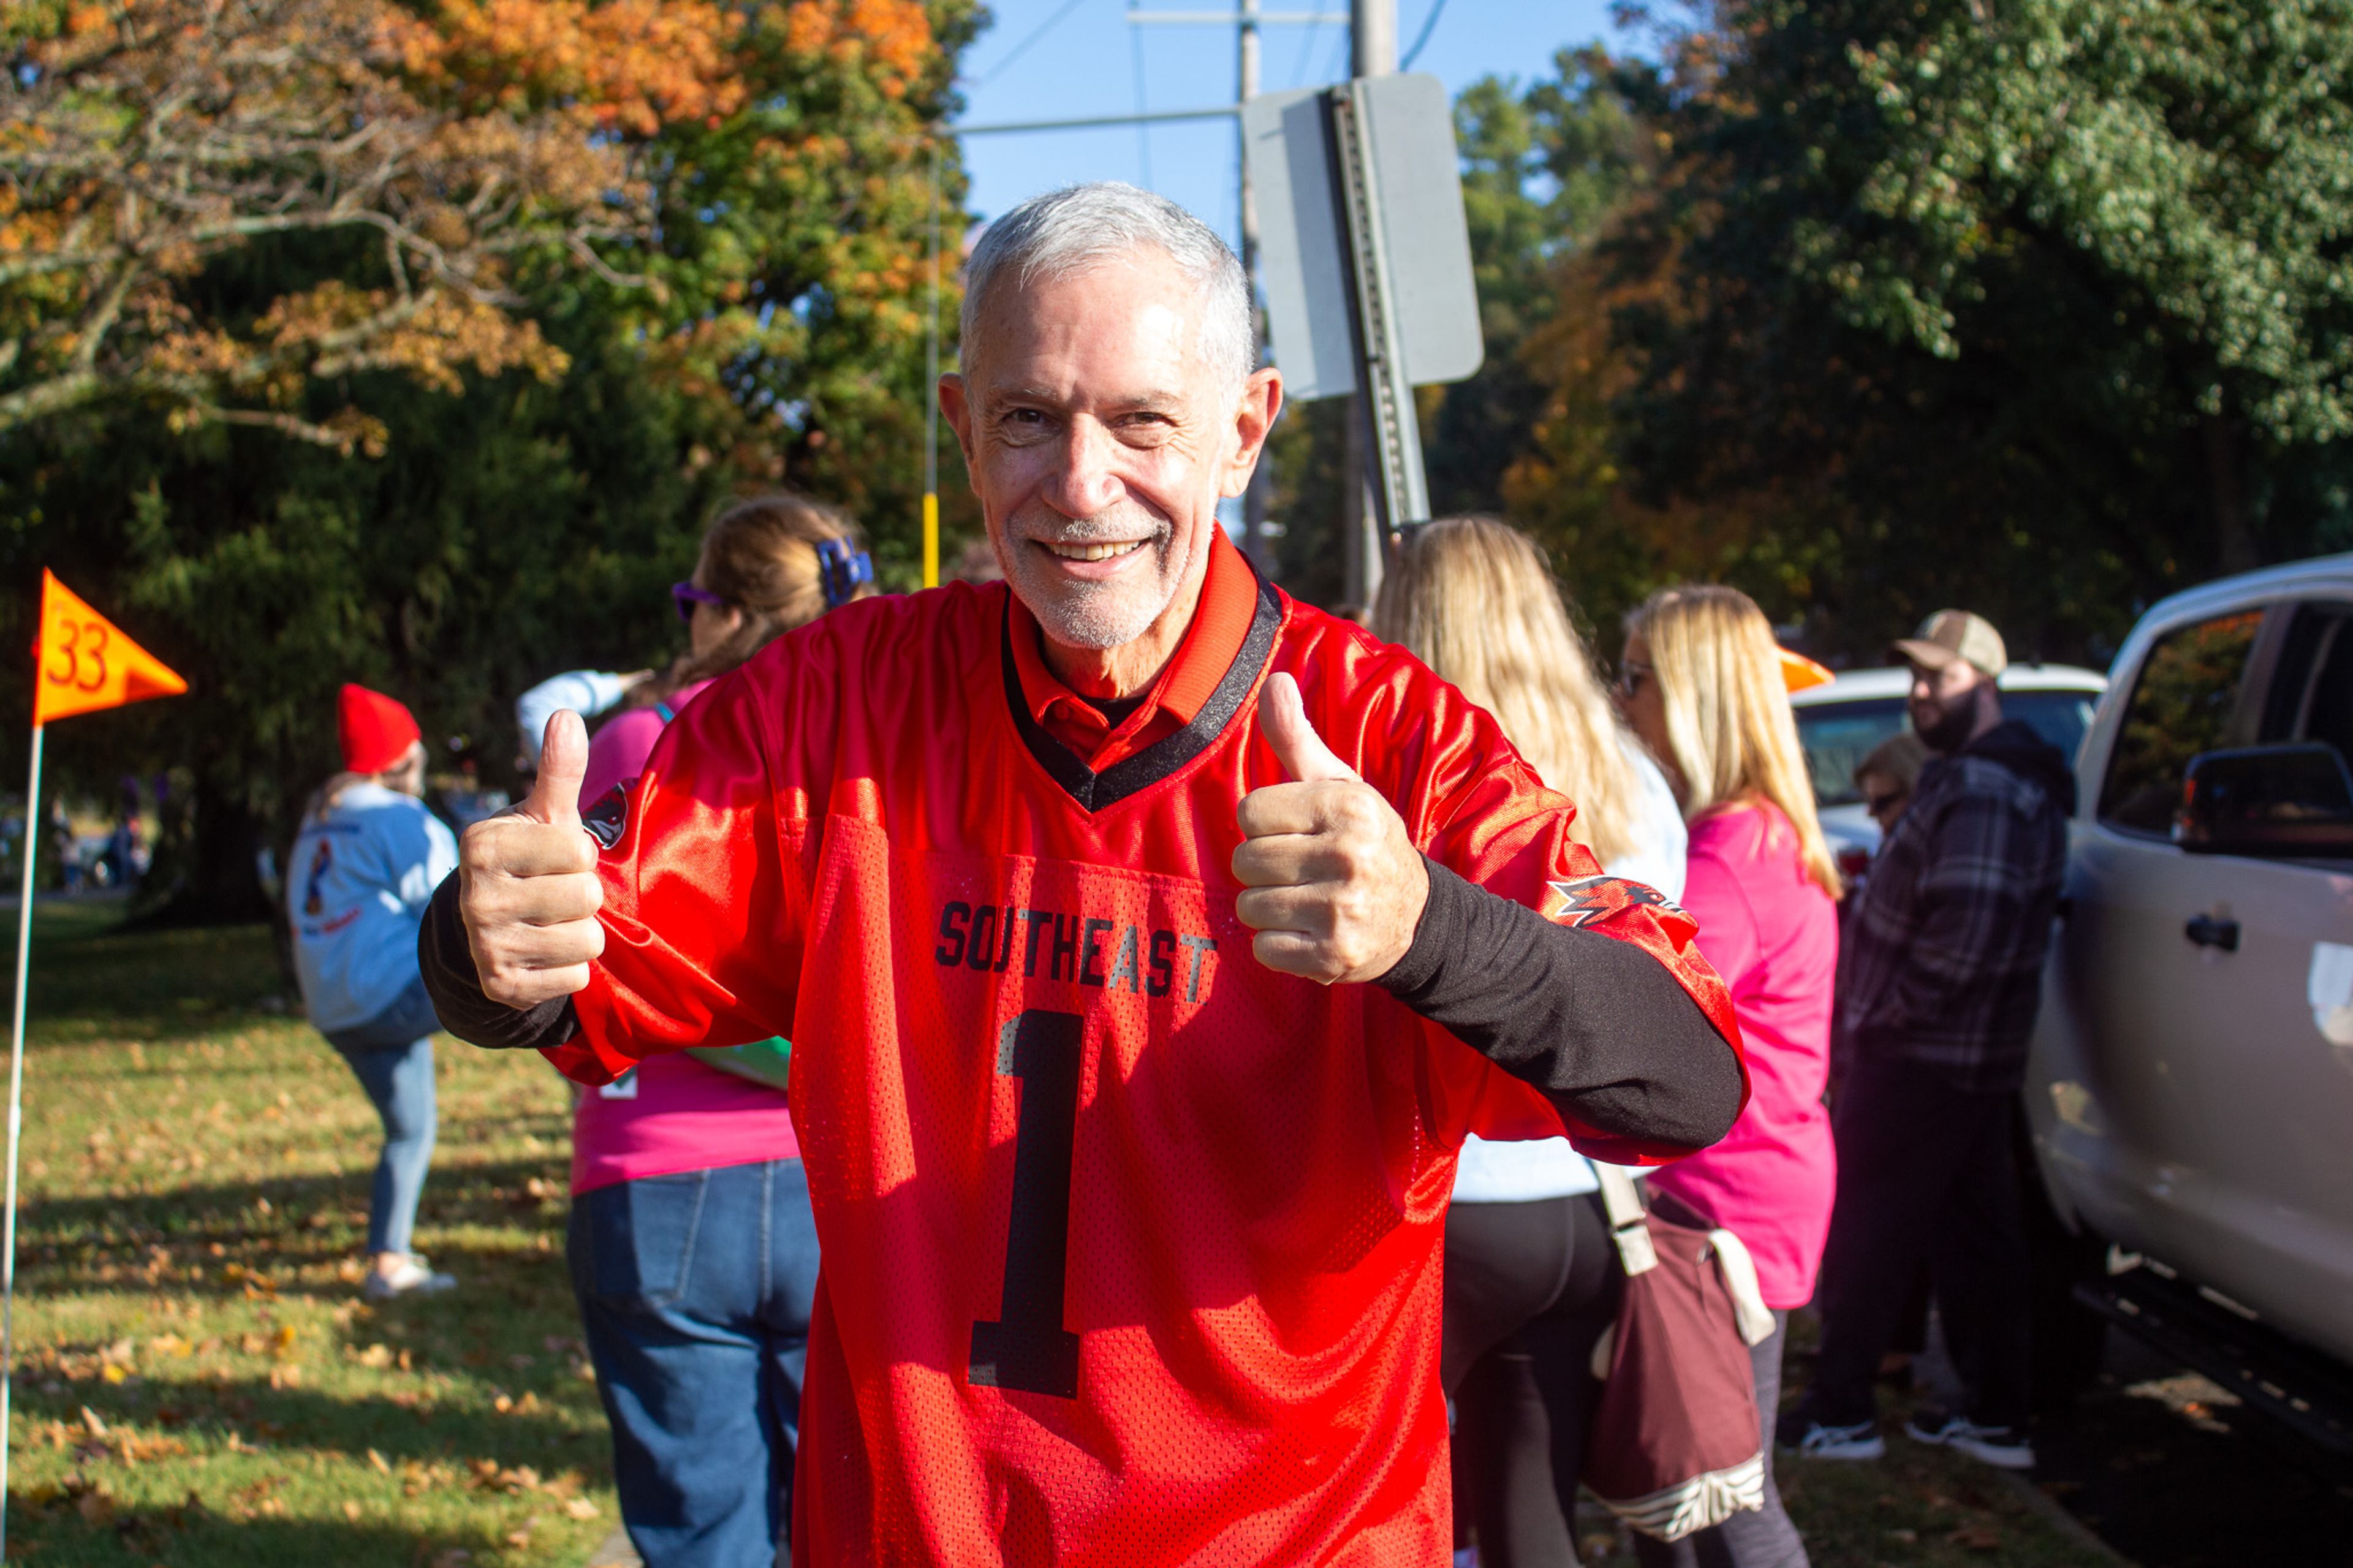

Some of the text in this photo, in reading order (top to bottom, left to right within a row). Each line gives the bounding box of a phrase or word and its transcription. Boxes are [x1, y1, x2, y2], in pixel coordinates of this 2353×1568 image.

[46, 619, 109, 695] 33
[935, 901, 1218, 1002] SOUTHEAST
[968, 1009, 1084, 1401] 1
